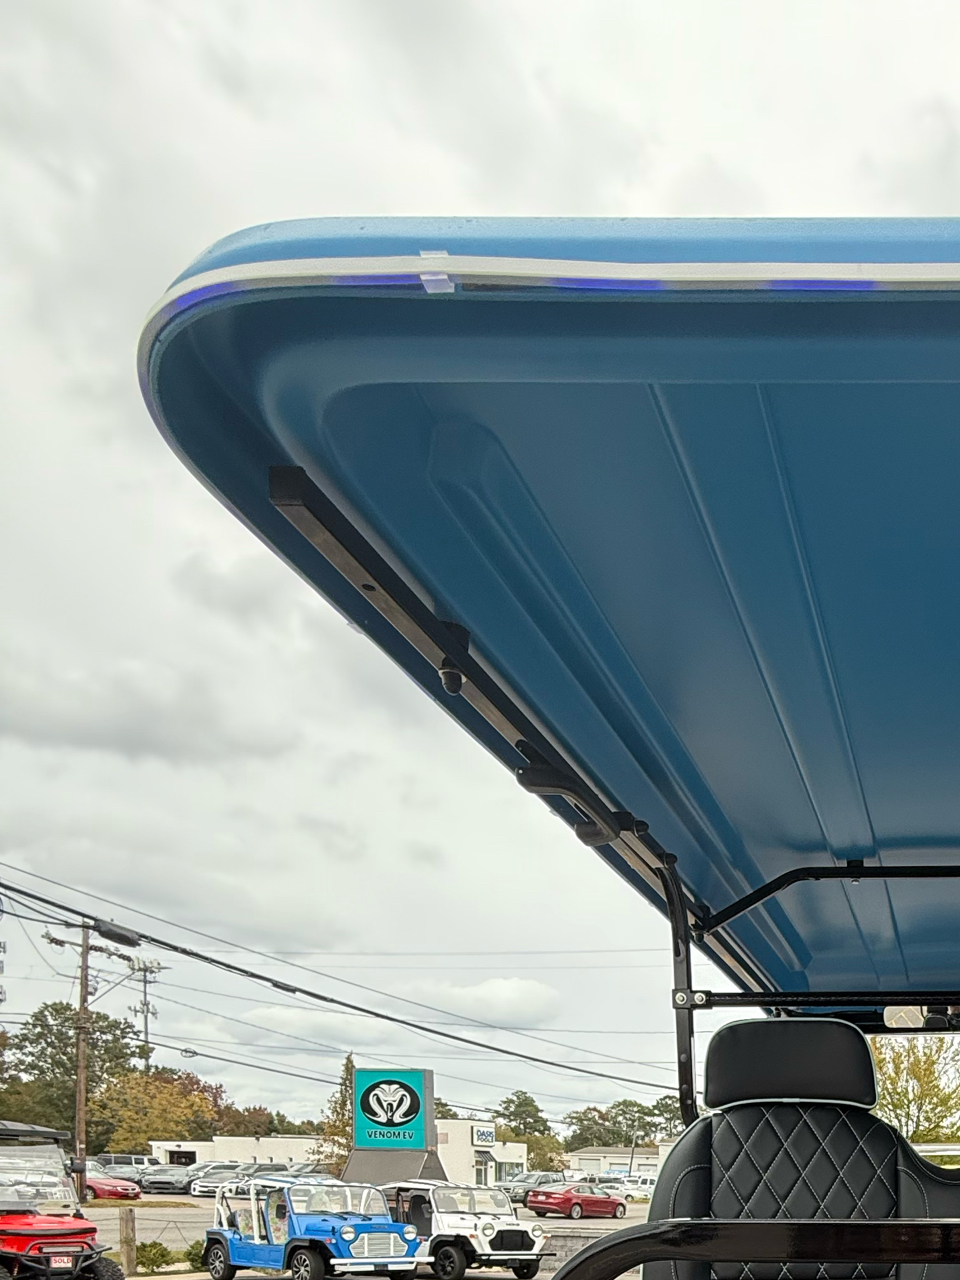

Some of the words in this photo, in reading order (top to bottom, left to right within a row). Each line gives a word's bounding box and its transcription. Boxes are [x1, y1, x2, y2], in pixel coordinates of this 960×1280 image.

[367, 1130, 400, 1139] VENOM
[403, 1131, 414, 1140] EV
[476, 1129, 494, 1138] OASIS
